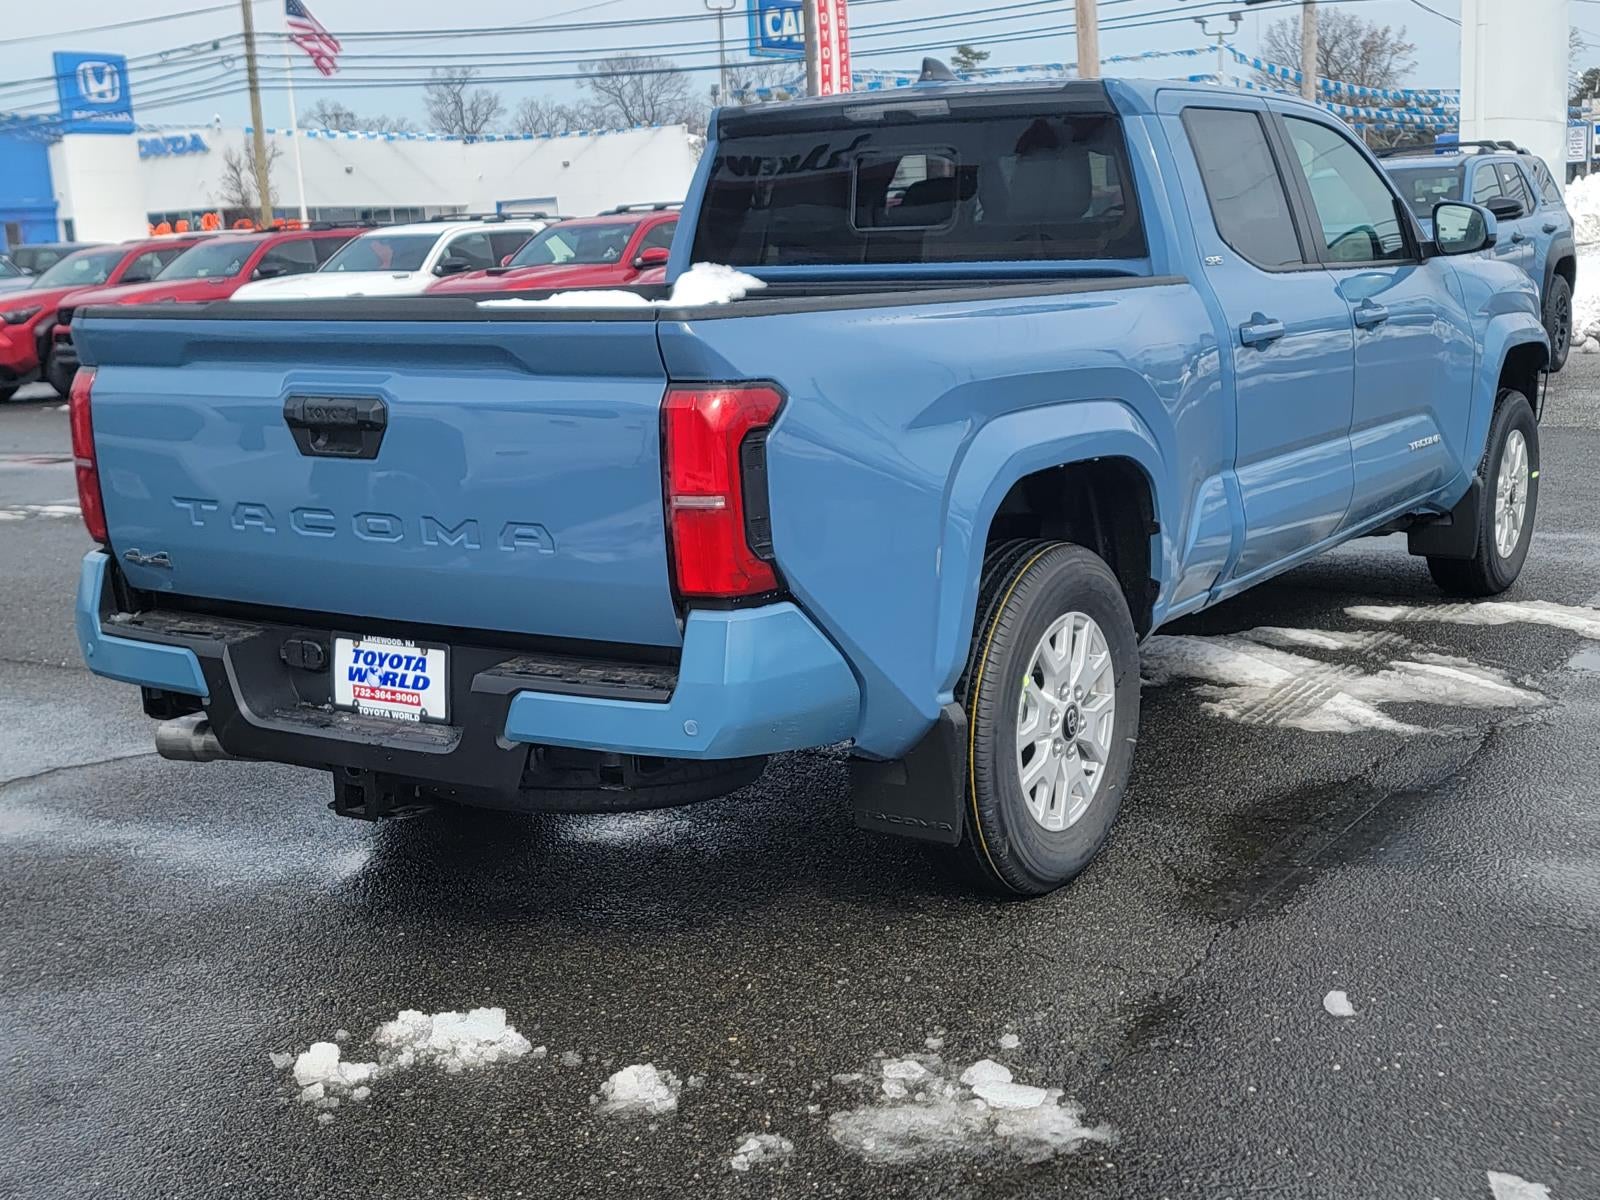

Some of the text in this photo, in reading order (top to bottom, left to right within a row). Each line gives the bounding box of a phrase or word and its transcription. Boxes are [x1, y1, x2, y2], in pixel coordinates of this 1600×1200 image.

[172, 496, 556, 553] TACOMA
[353, 648, 427, 673] TOYOTA
[348, 666, 431, 691] WORLD
[354, 686, 419, 704] 732-364-9000
[358, 706, 420, 722] TOYOTA WORLD
